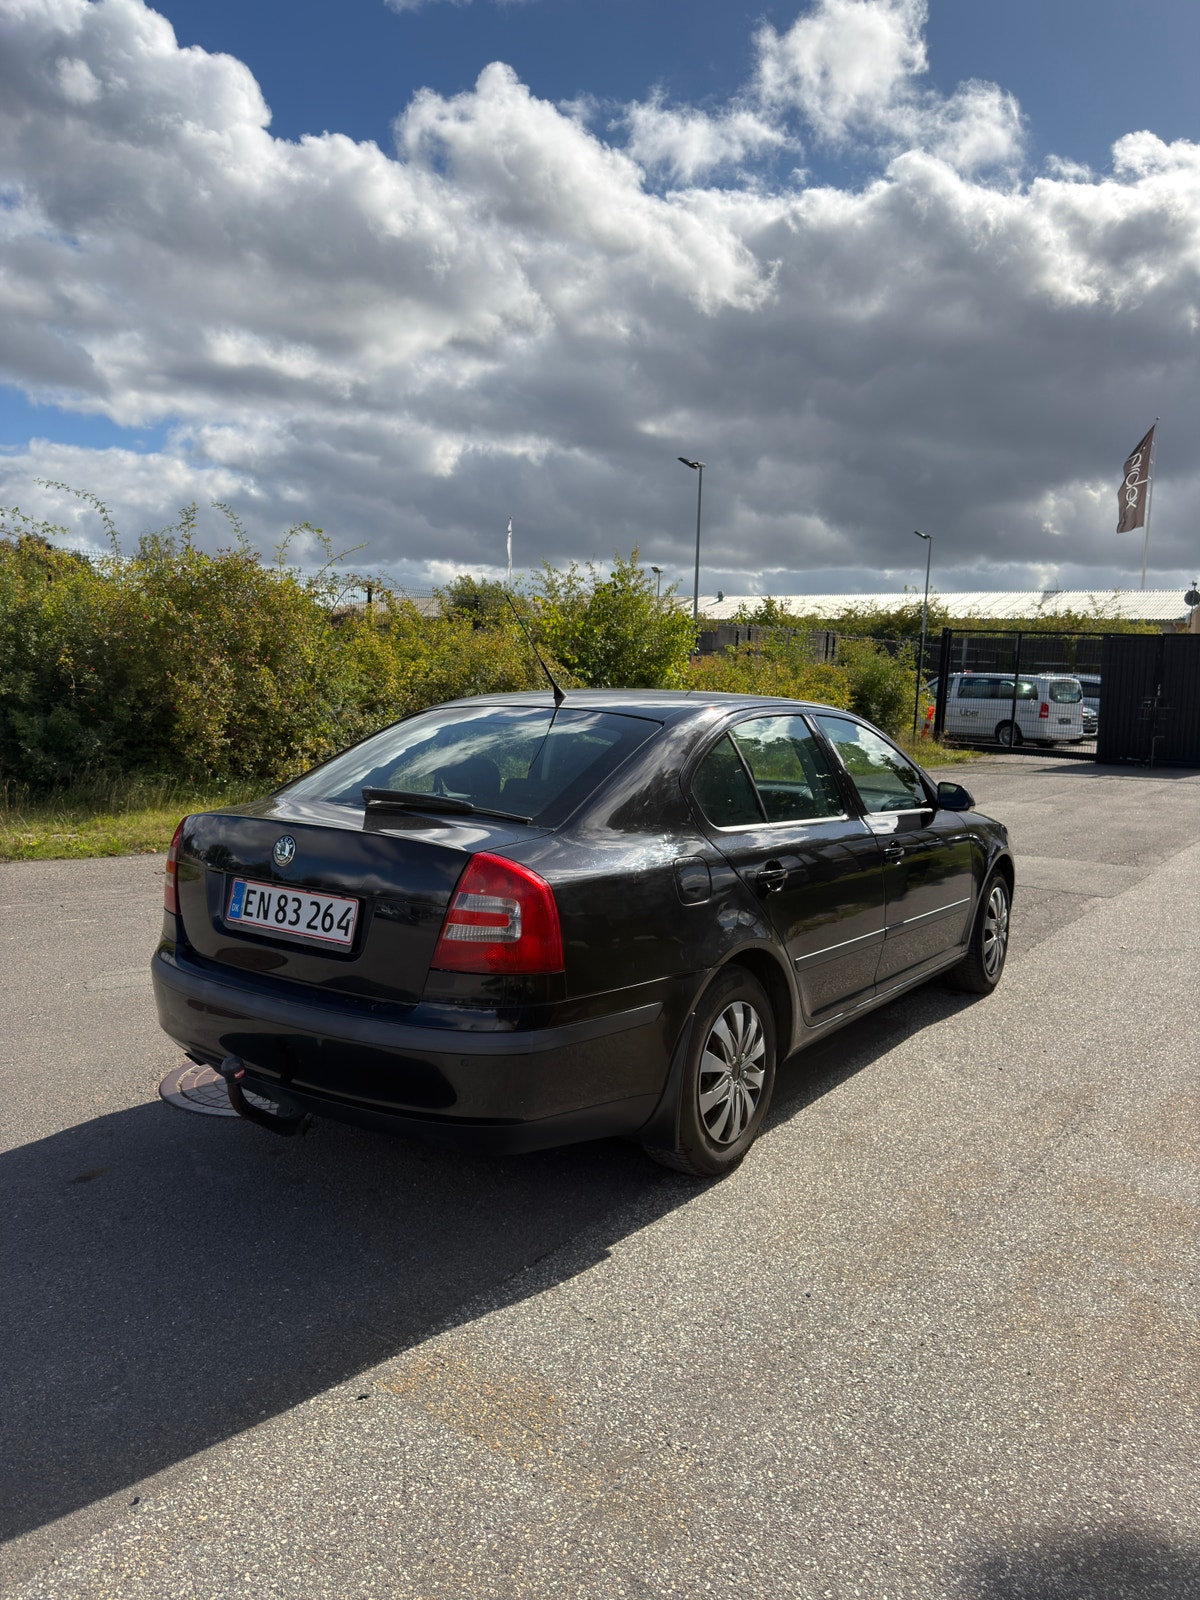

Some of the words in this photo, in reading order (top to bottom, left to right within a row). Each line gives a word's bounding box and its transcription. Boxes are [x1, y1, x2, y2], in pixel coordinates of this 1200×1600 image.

[960, 708, 979, 718] Uber
[231, 902, 239, 912] DK
[243, 889, 272, 920] EN
[275, 894, 302, 926] 83
[306, 901, 352, 936] 264
